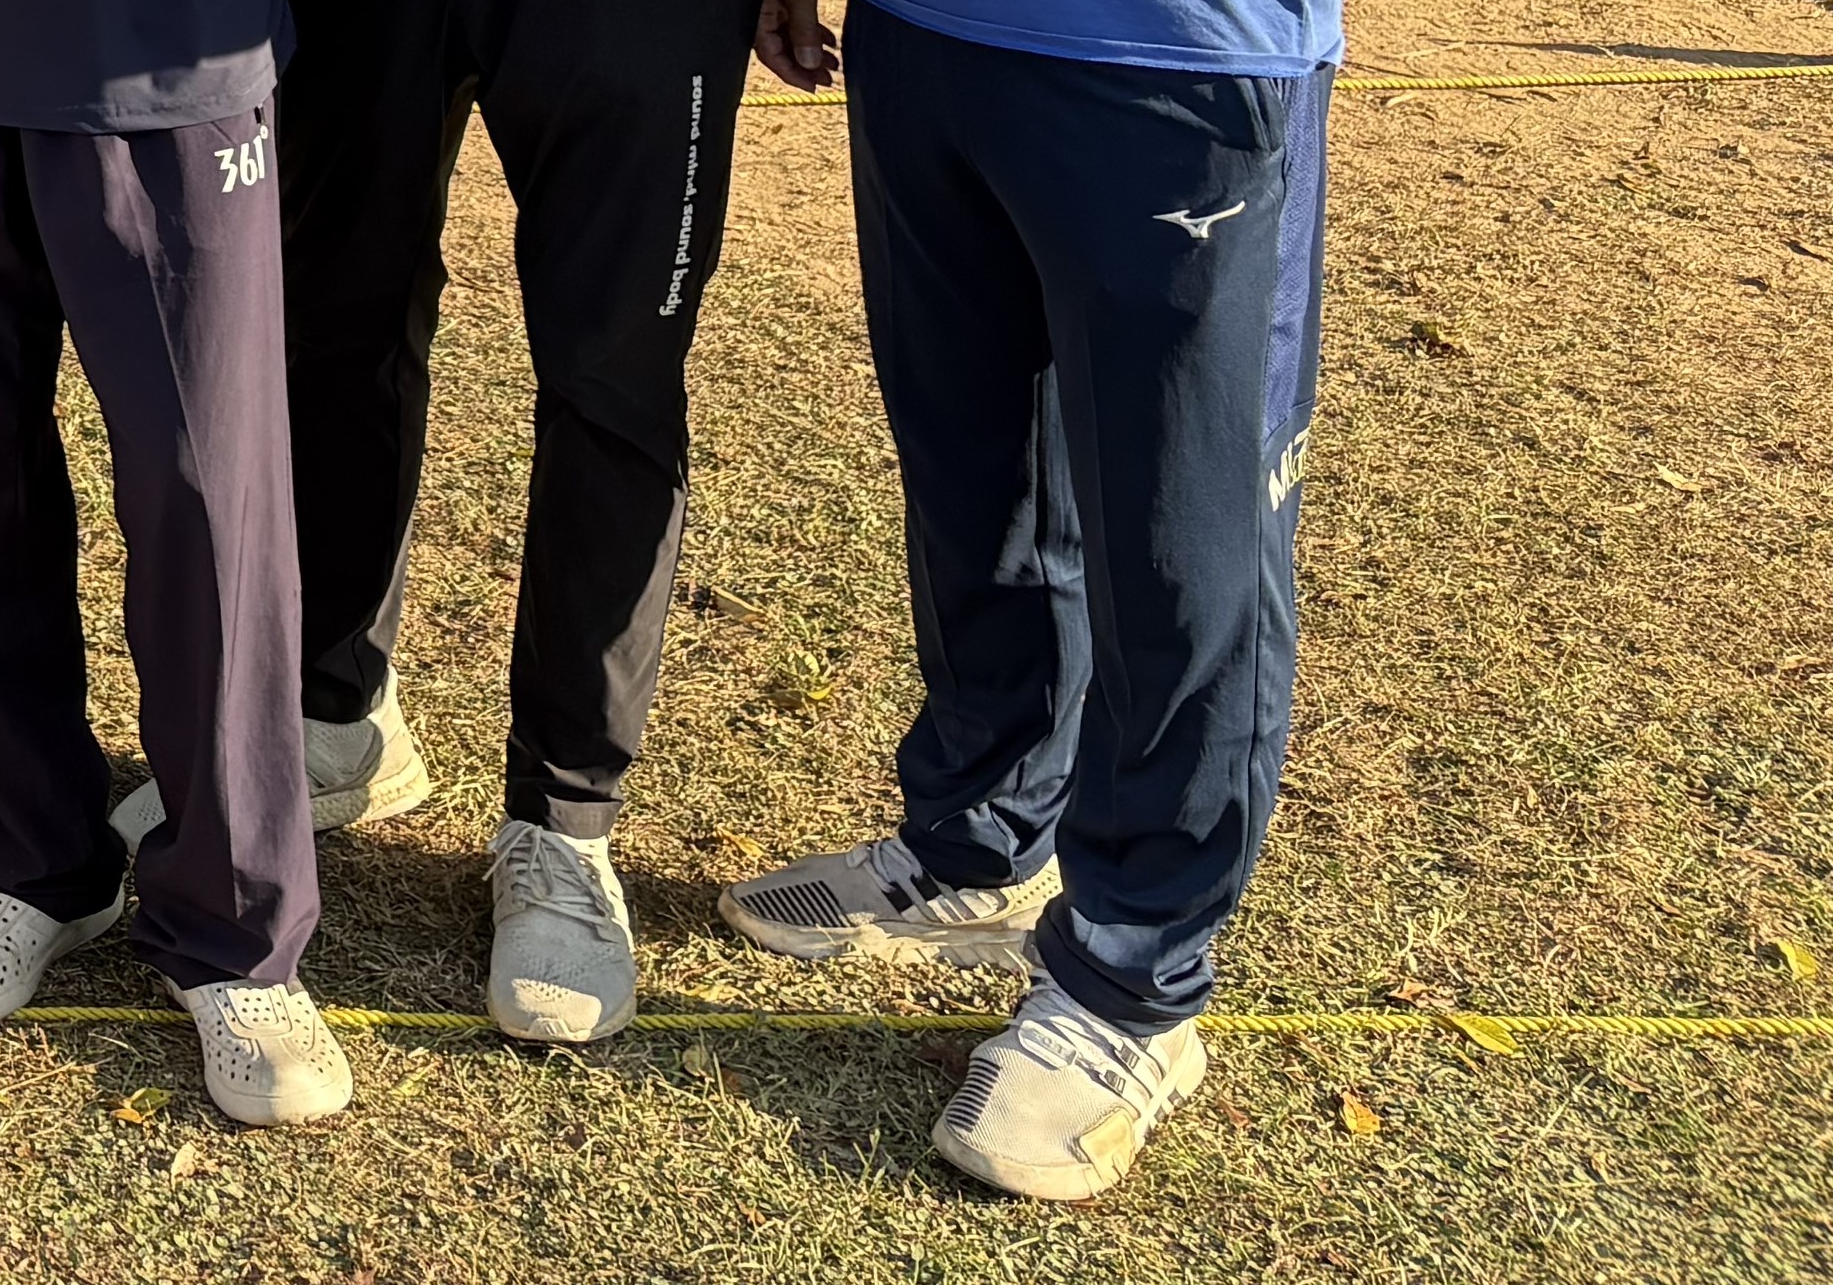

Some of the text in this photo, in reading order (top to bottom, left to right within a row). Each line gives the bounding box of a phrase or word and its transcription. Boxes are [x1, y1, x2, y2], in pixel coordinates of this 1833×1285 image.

[690, 75, 702, 140] sound
[675, 203, 694, 265] sound
[659, 268, 689, 316] body
